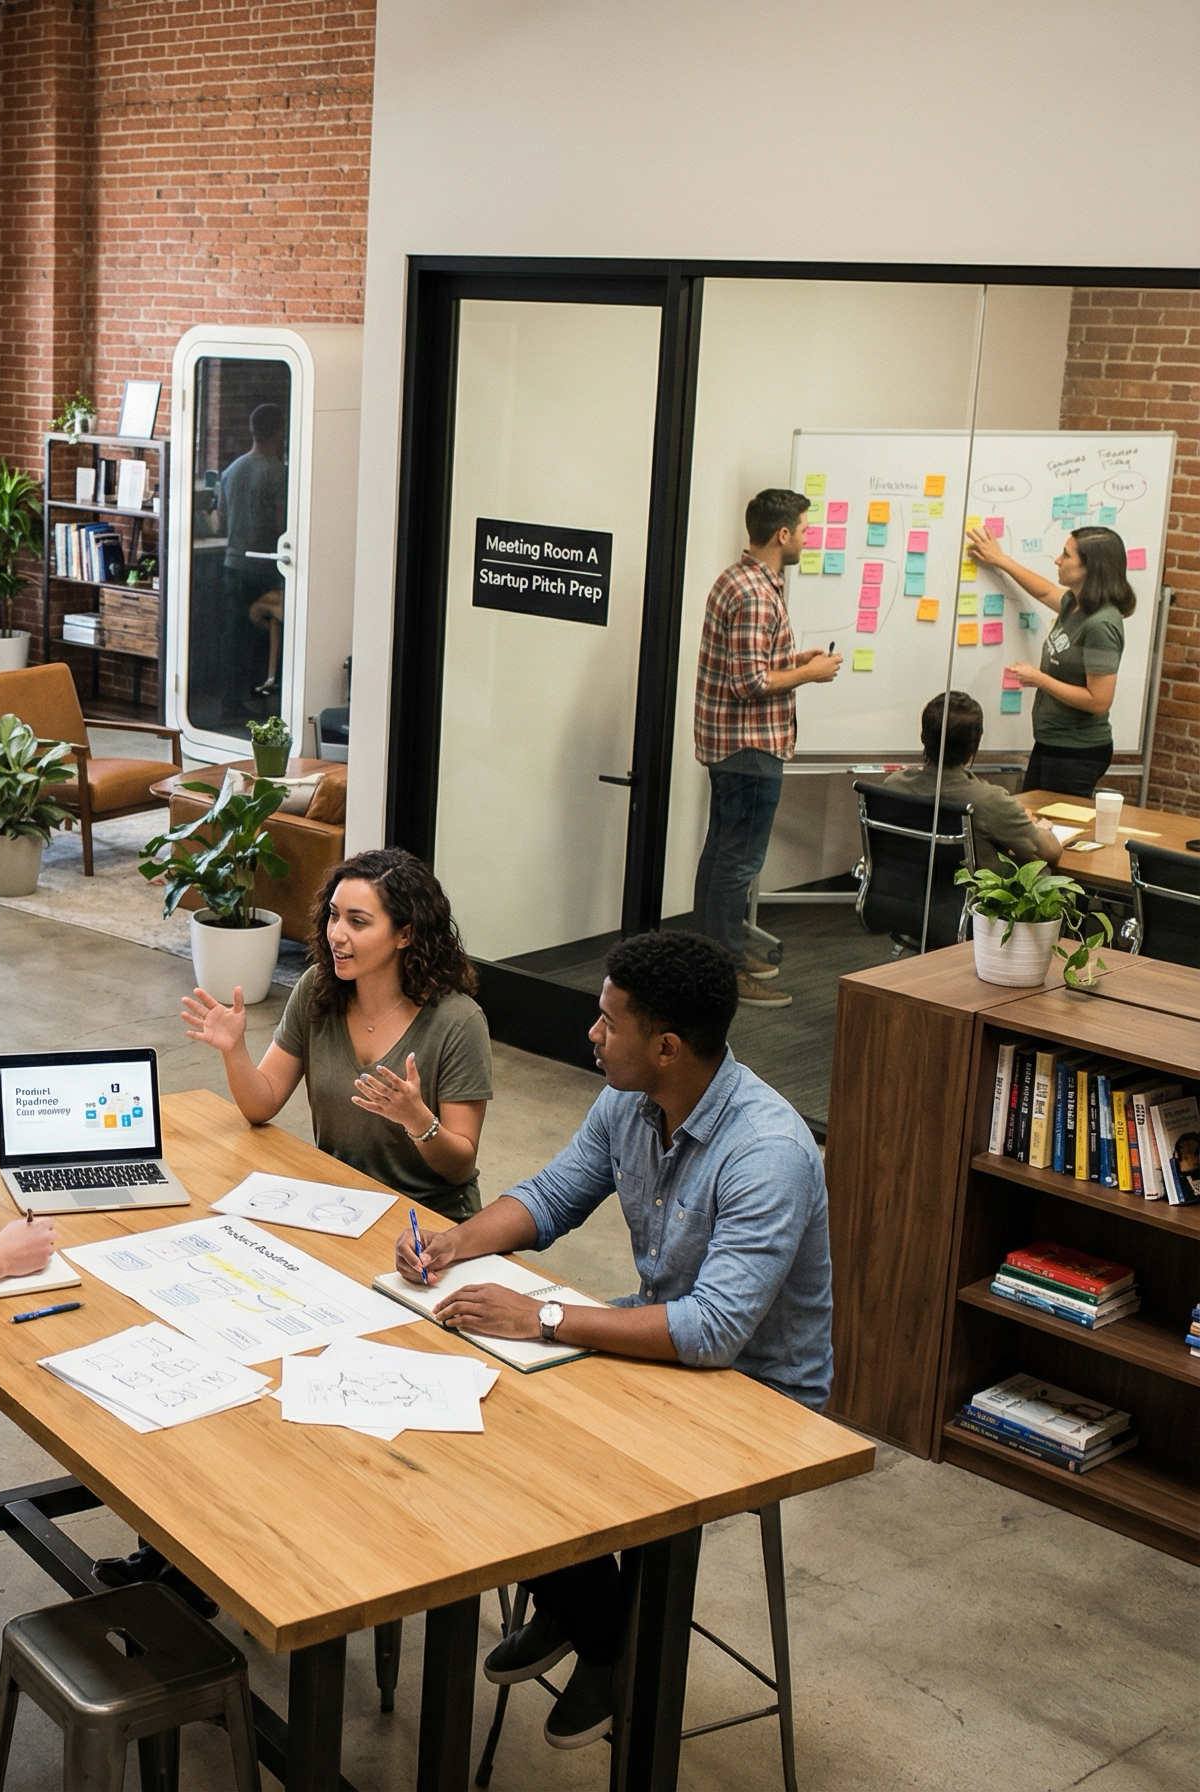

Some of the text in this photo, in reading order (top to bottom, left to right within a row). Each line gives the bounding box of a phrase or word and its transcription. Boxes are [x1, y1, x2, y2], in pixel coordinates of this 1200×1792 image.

[486, 535, 598, 564] Meeting Room A
[479, 568, 602, 604] Startup Pitch Prep
